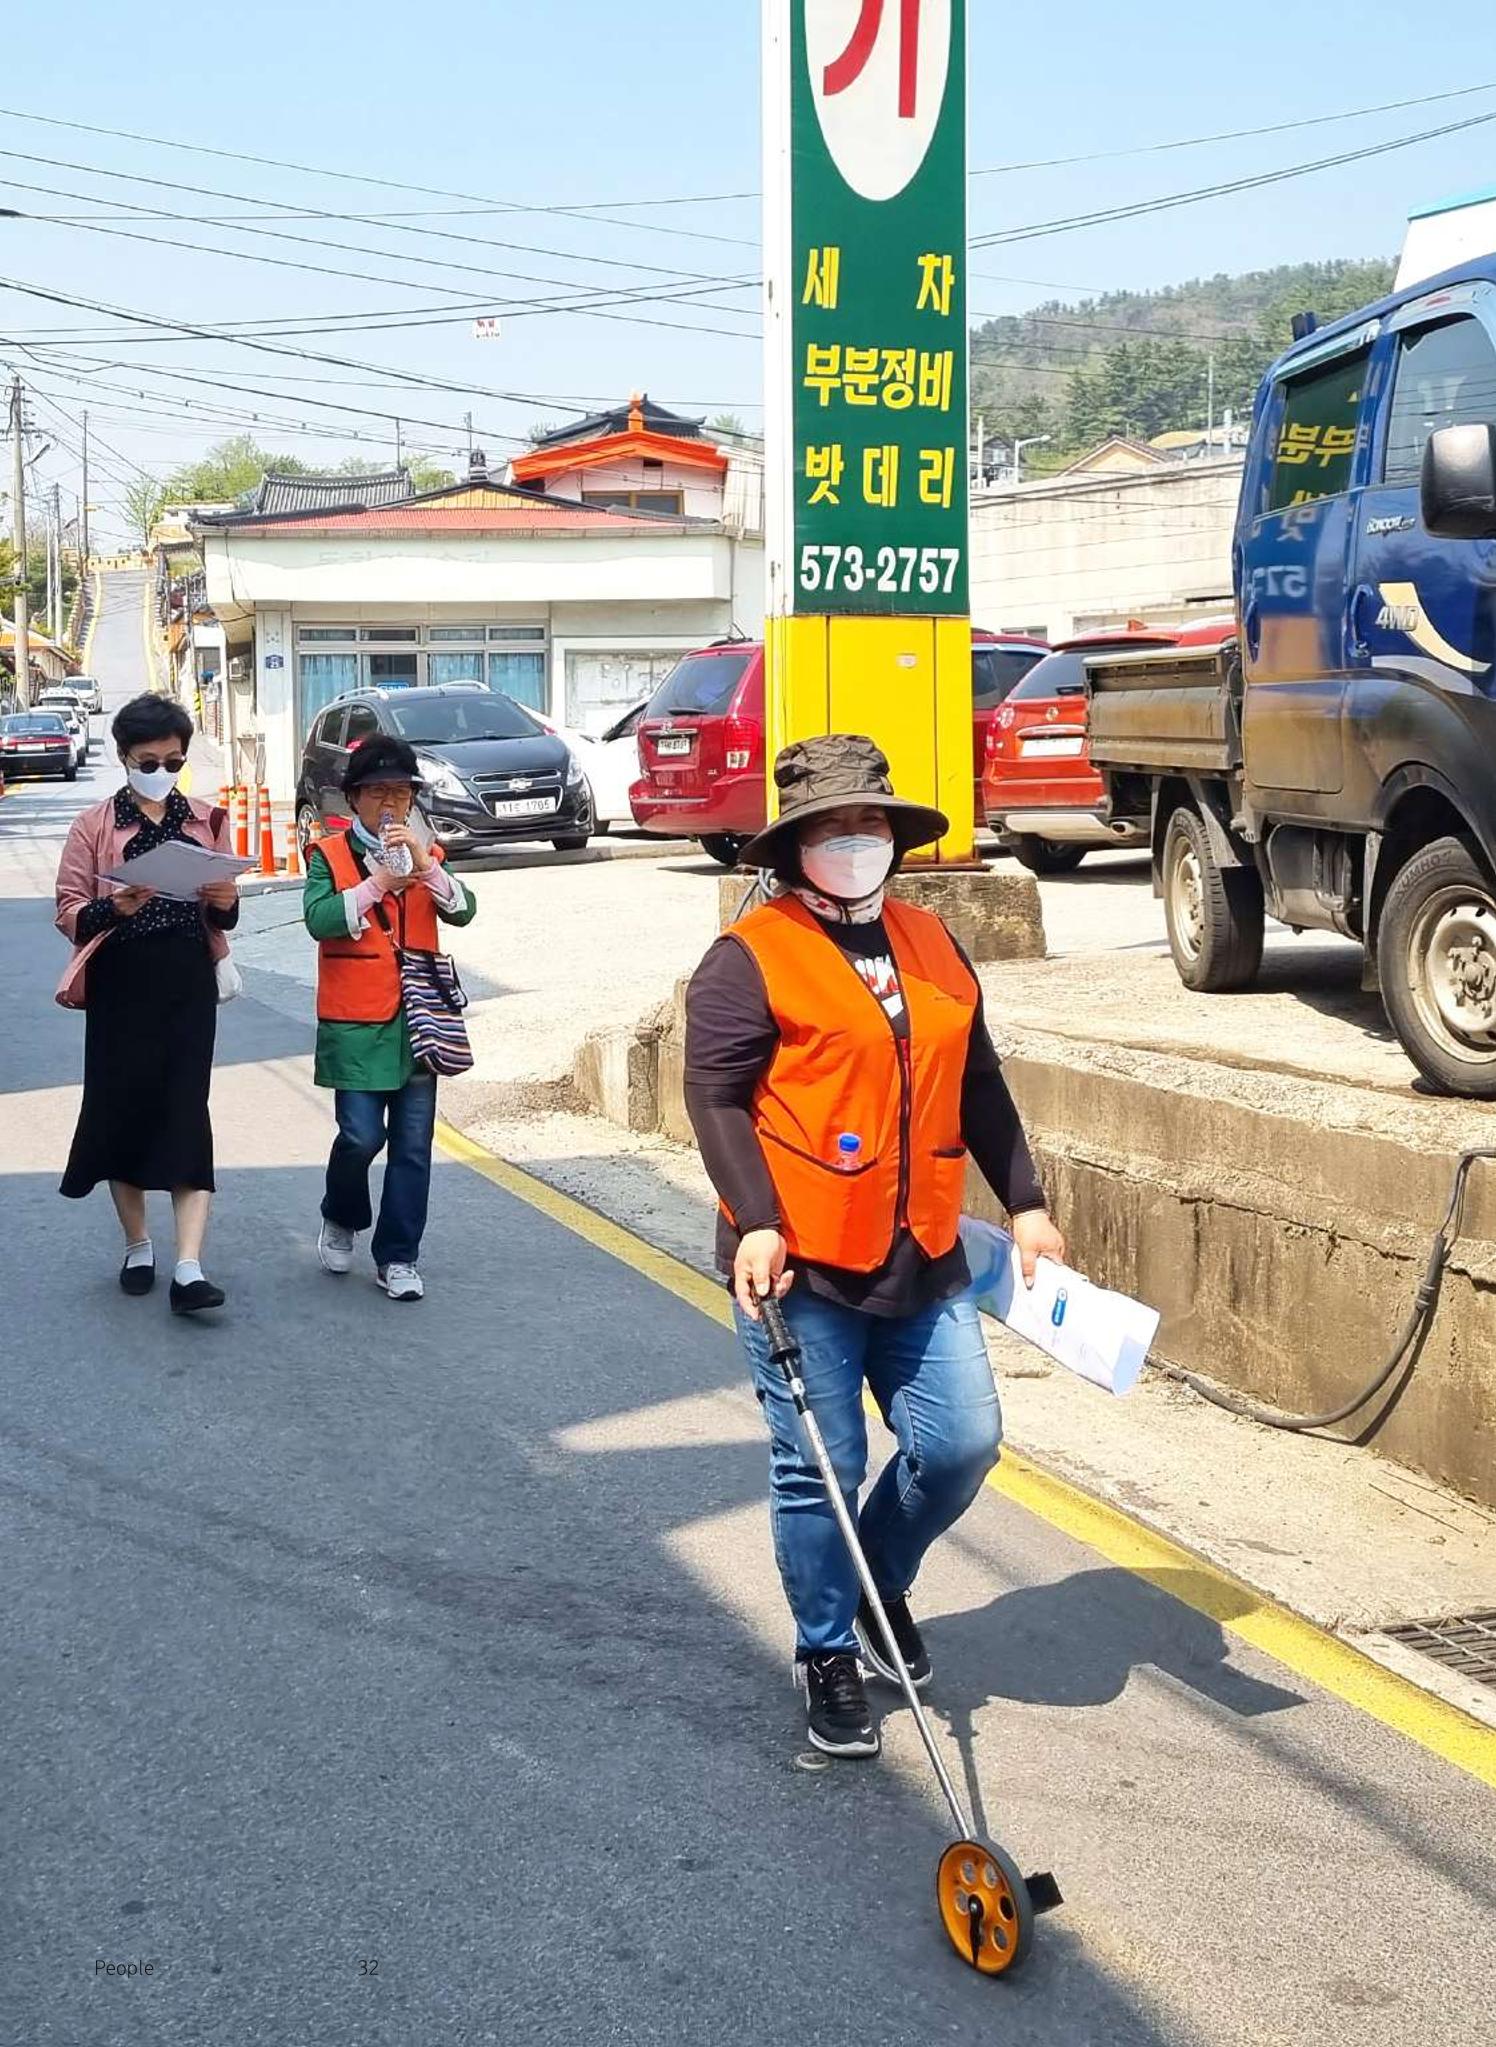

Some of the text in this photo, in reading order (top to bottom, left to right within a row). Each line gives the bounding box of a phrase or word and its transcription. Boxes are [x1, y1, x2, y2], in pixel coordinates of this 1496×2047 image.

[802, 246, 955, 316] 세 차
[803, 343, 954, 411] 부분정비
[800, 545, 961, 593] 573-2757
[1375, 605, 1420, 632] 4WD
